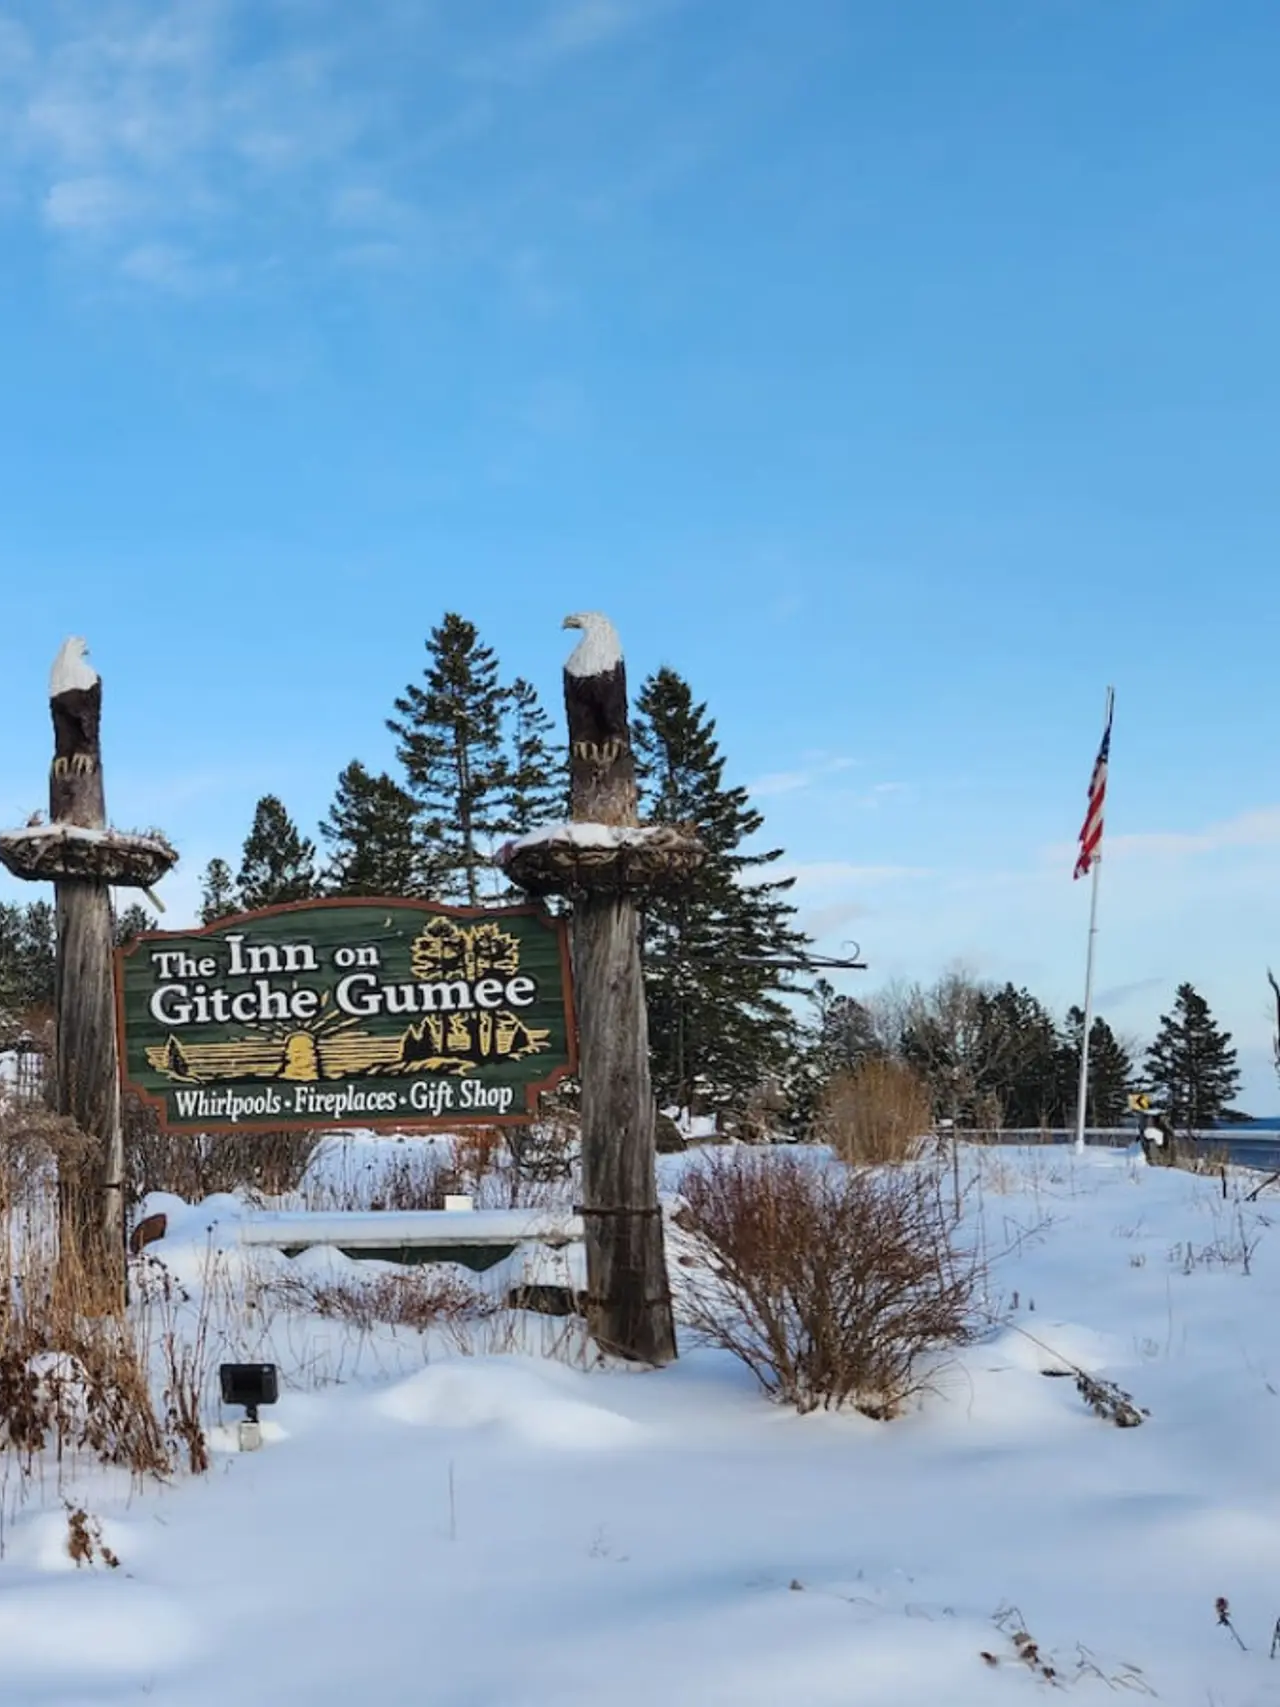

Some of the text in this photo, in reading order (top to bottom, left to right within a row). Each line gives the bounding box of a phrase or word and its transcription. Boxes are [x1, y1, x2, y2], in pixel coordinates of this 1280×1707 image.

[152, 934, 380, 979] The Inn on
[150, 973, 536, 1025] Gitche Gumee
[175, 1079, 513, 1123] Whirlpools Fireplaces Gift Shop
